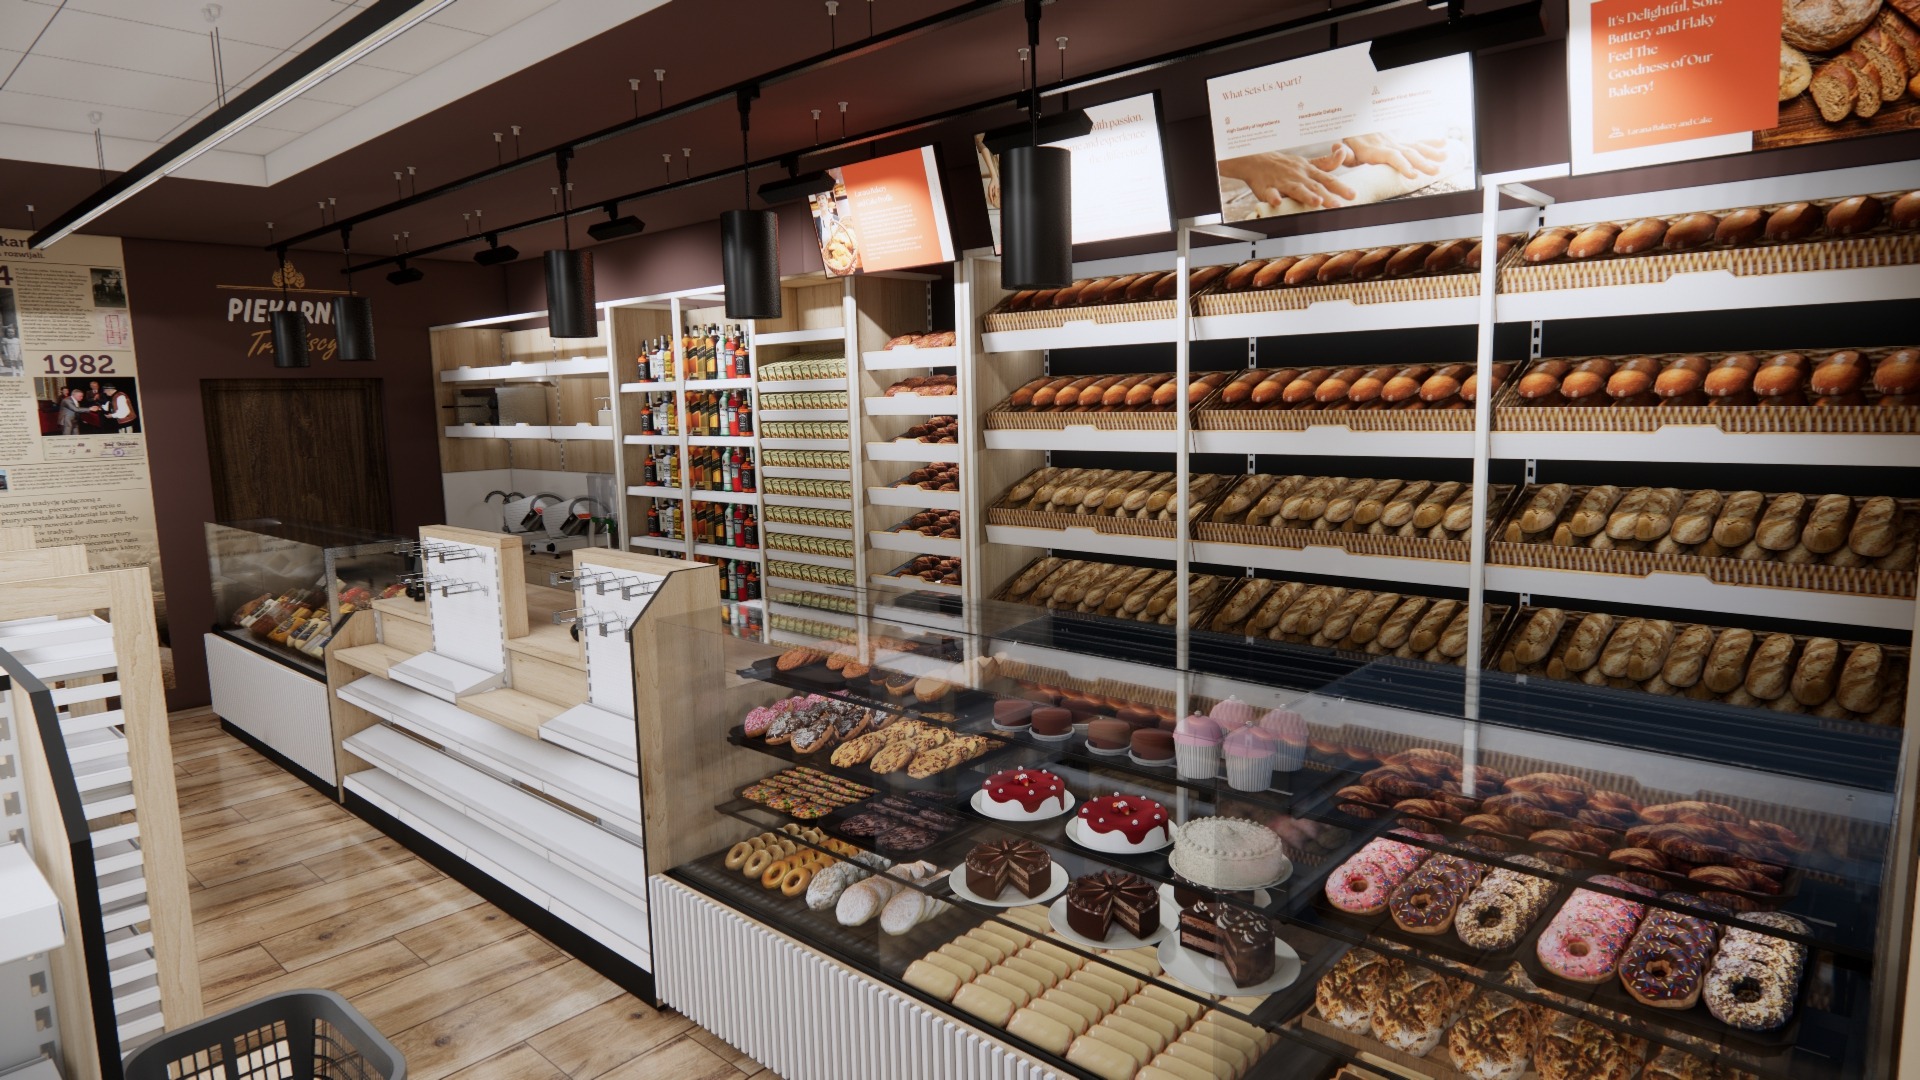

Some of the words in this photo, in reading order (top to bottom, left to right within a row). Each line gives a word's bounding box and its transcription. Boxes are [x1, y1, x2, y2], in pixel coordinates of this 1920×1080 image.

[1608, 15, 1624, 27] It's
[1627, 0, 1690, 22] Delightful,
[1608, 28, 1653, 45] Buttery
[1656, 19, 1679, 35] and
[1682, 14, 1717, 30] Flaky
[1608, 47, 1633, 63] Feel
[1635, 45, 1658, 57] The
[1608, 62, 1669, 80] Goodness
[1671, 55, 1687, 68] of
[1687, 53, 1713, 65] Our
[1222, 90, 1243, 100] What
[1244, 86, 1262, 96] Sets
[1262, 83, 1274, 92] Us
[1275, 76, 1302, 91] Apart?
[1608, 81, 1654, 98] Bakery!
[1091, 120, 1107, 132] with
[1109, 114, 1144, 130] passion.
[1678, 118, 1693, 127] and
[1100, 129, 1146, 148] experience
[0, 235, 30, 248] kar
[4, 251, 45, 260] rozwijali.
[228, 297, 335, 325] PIEKRN
[247, 329, 338, 361] Trscy
[43, 354, 116, 375] 1982
